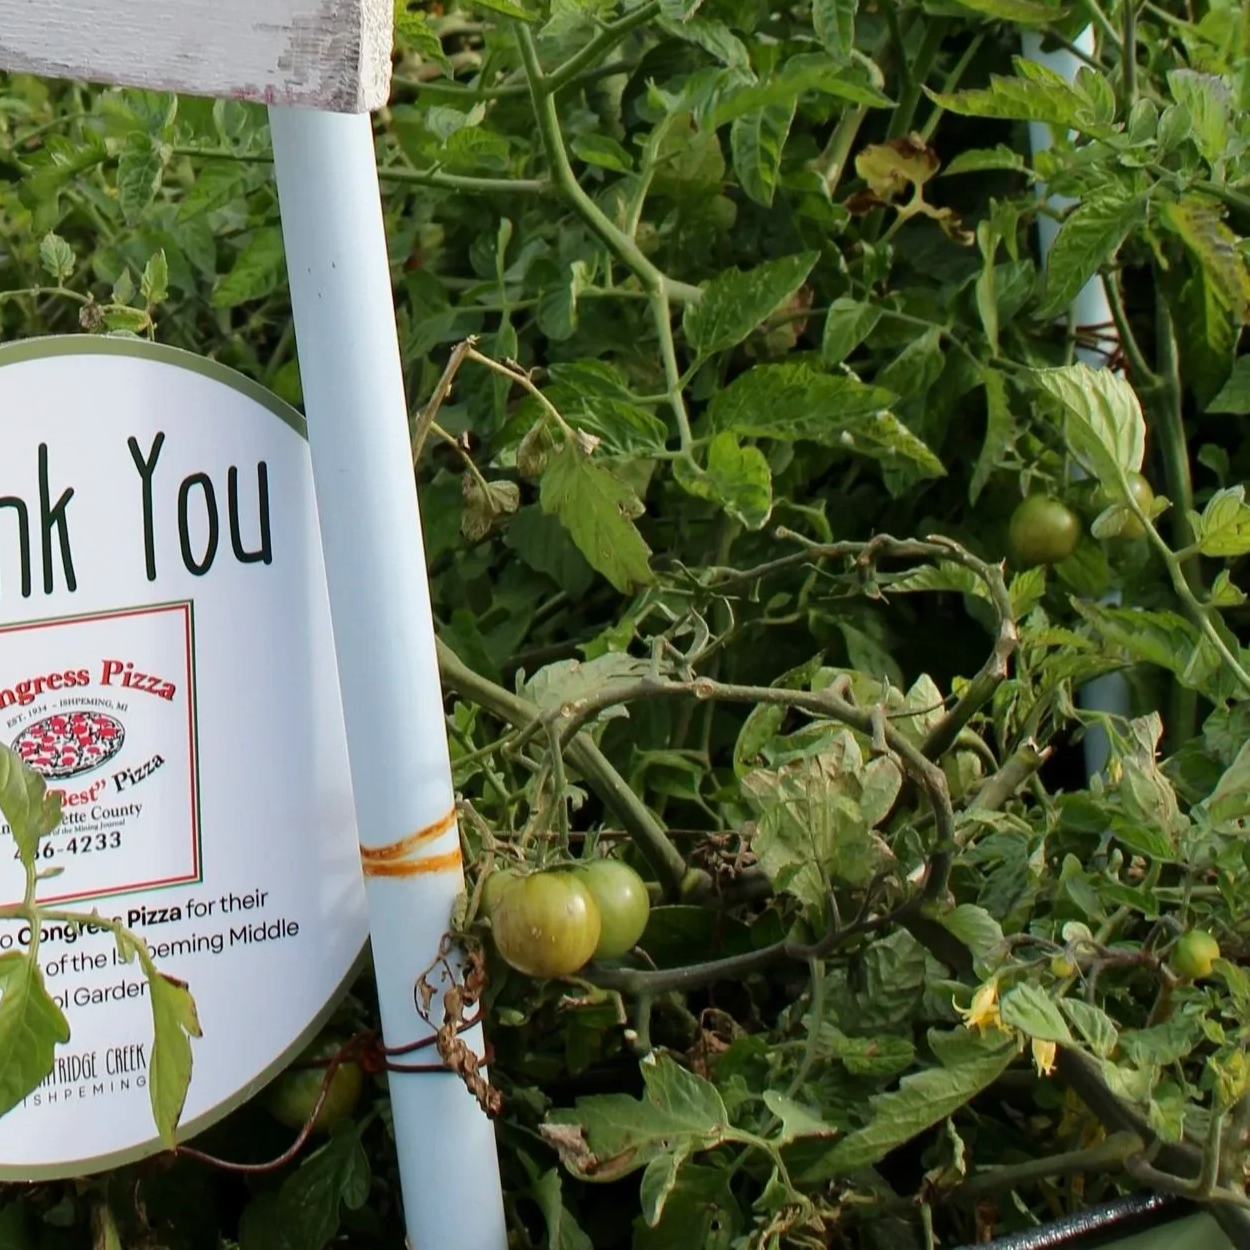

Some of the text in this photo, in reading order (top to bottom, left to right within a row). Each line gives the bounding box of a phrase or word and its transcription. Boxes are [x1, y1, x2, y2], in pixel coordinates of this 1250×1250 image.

[127, 431, 273, 581] You
[100, 658, 176, 701] Pizza
[111, 753, 165, 793] Pizza
[91, 803, 142, 821] County
[14, 831, 122, 860] 6-4233
[127, 905, 182, 928] Pizza
[186, 898, 216, 920] for
[219, 888, 268, 913] their
[46, 955, 68, 977] of
[71, 951, 108, 973] the
[229, 918, 300, 947] Middle
[38, 1042, 147, 1089] TRIDGE CREEK
